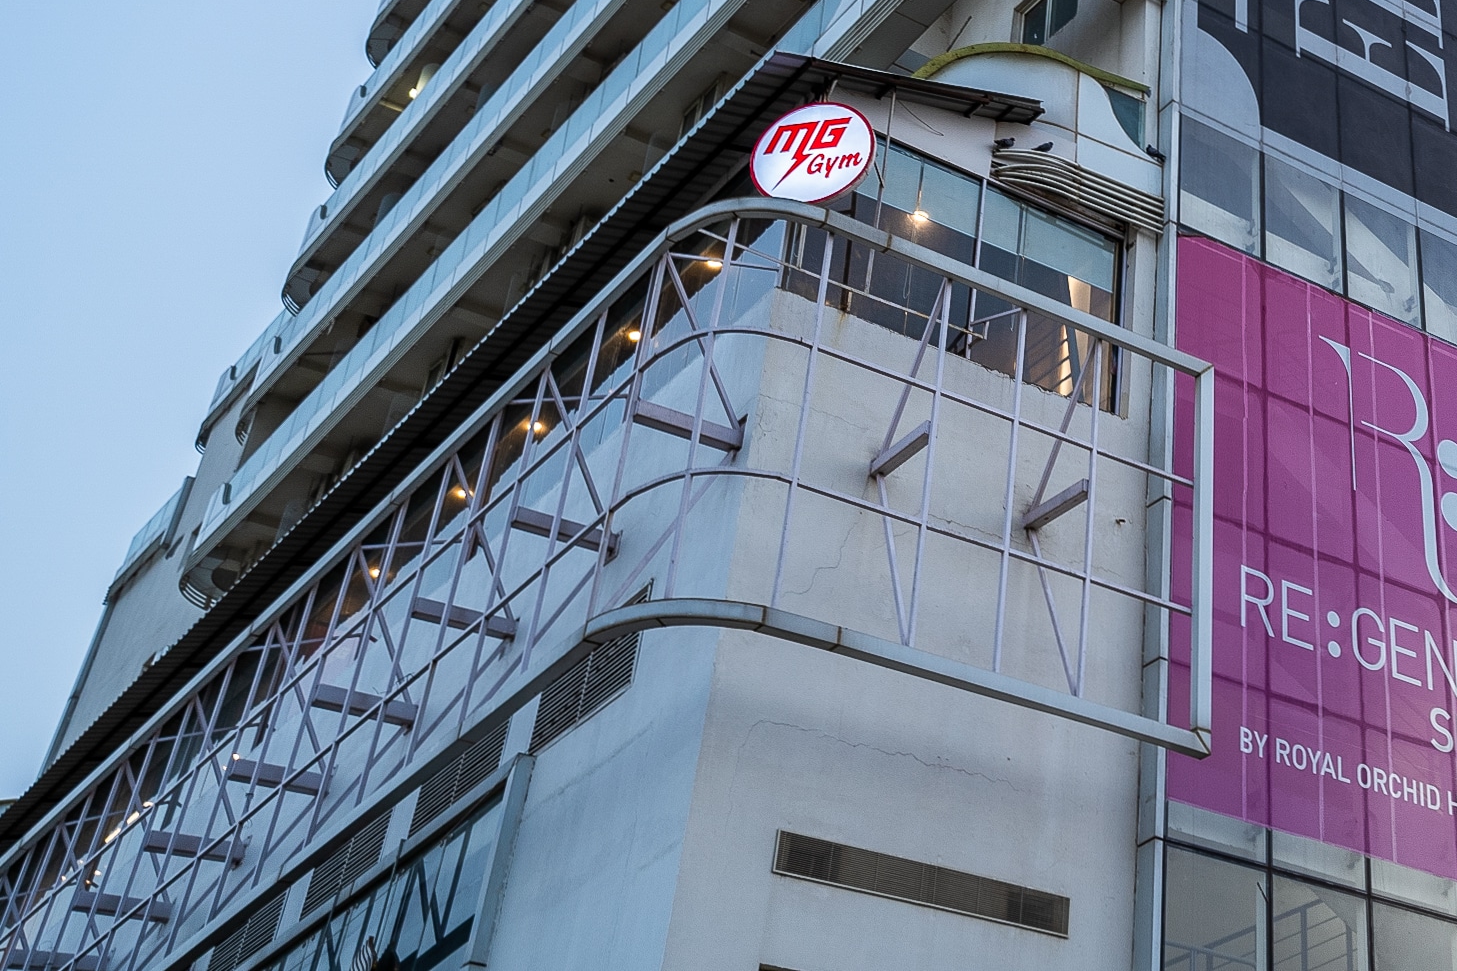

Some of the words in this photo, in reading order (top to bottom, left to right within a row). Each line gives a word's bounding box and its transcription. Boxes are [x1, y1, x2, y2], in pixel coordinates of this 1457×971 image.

[763, 117, 853, 183] MG
[807, 151, 863, 178] Gym
[1239, 726, 1268, 758] BY
[1275, 738, 1350, 783] ROYAL
[1357, 763, 1440, 811] ORCHID
